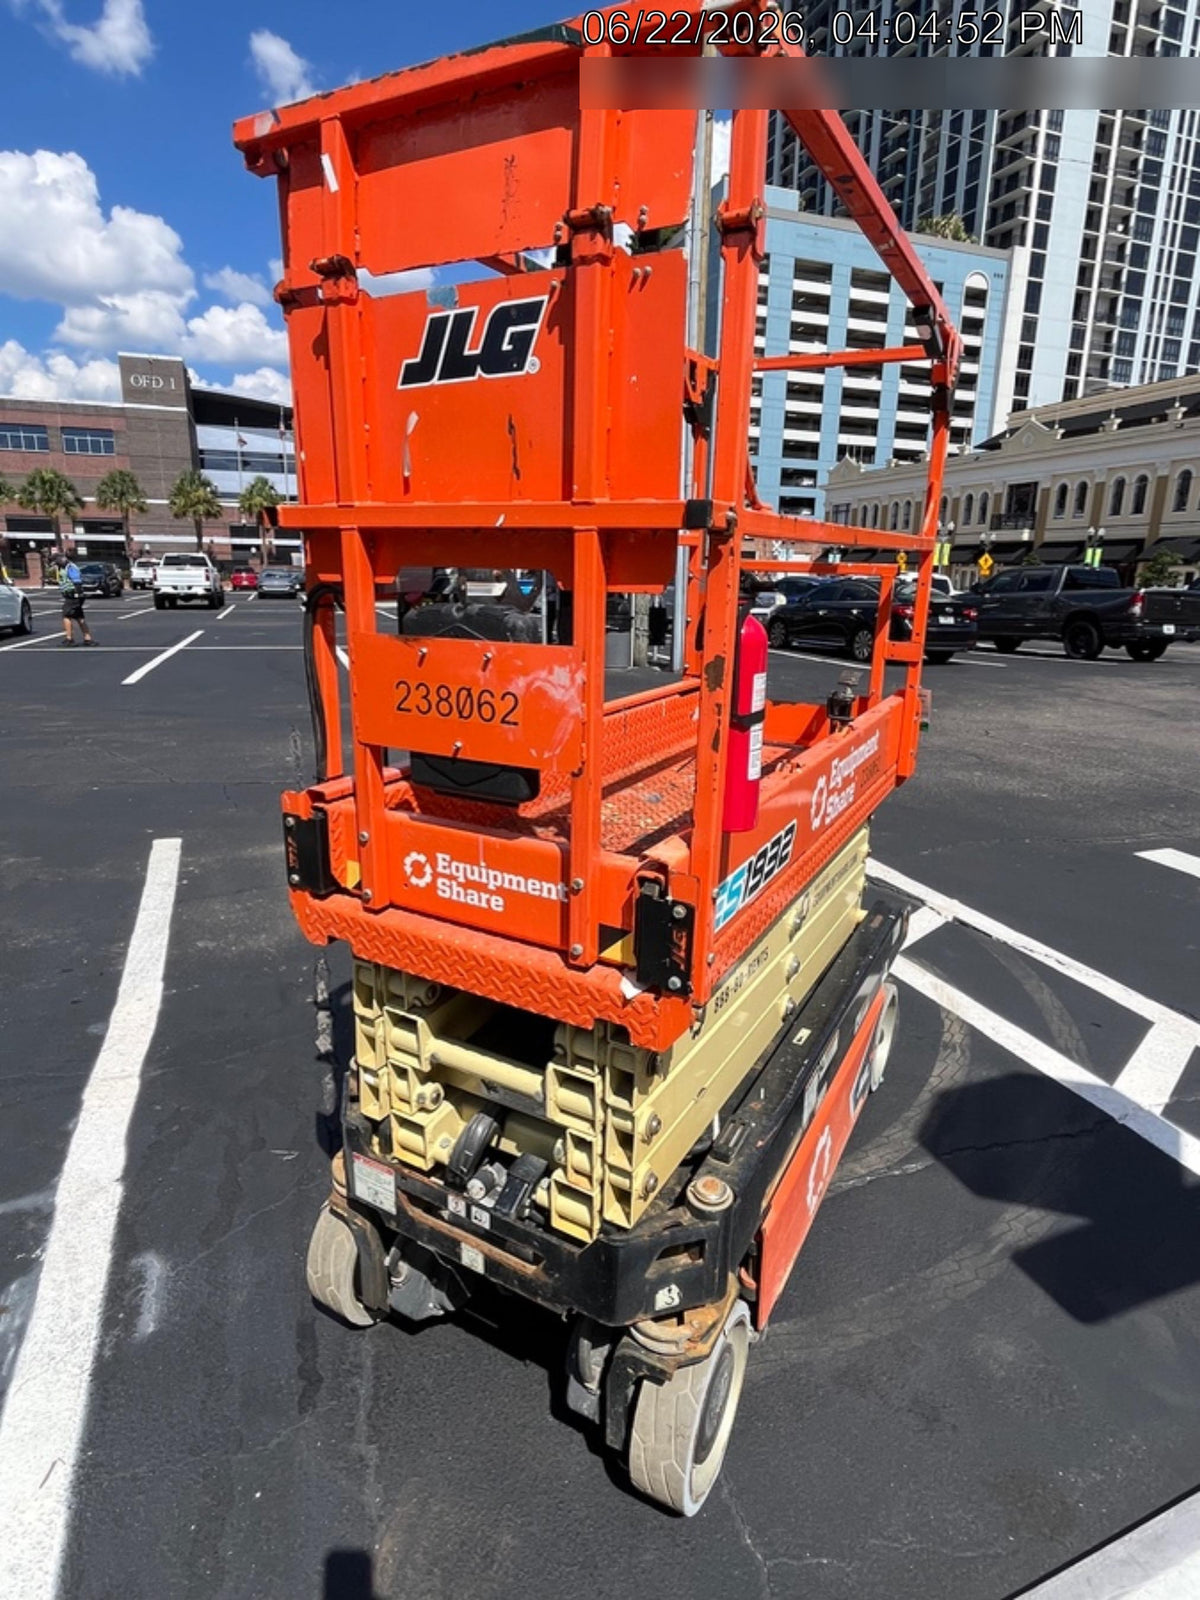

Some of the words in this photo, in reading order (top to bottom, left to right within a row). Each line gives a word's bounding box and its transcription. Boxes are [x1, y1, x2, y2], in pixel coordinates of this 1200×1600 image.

[130, 373, 164, 389] OFD
[395, 680, 519, 726] 238062
[436, 852, 569, 903] Equipment
[436, 878, 504, 911] Share
